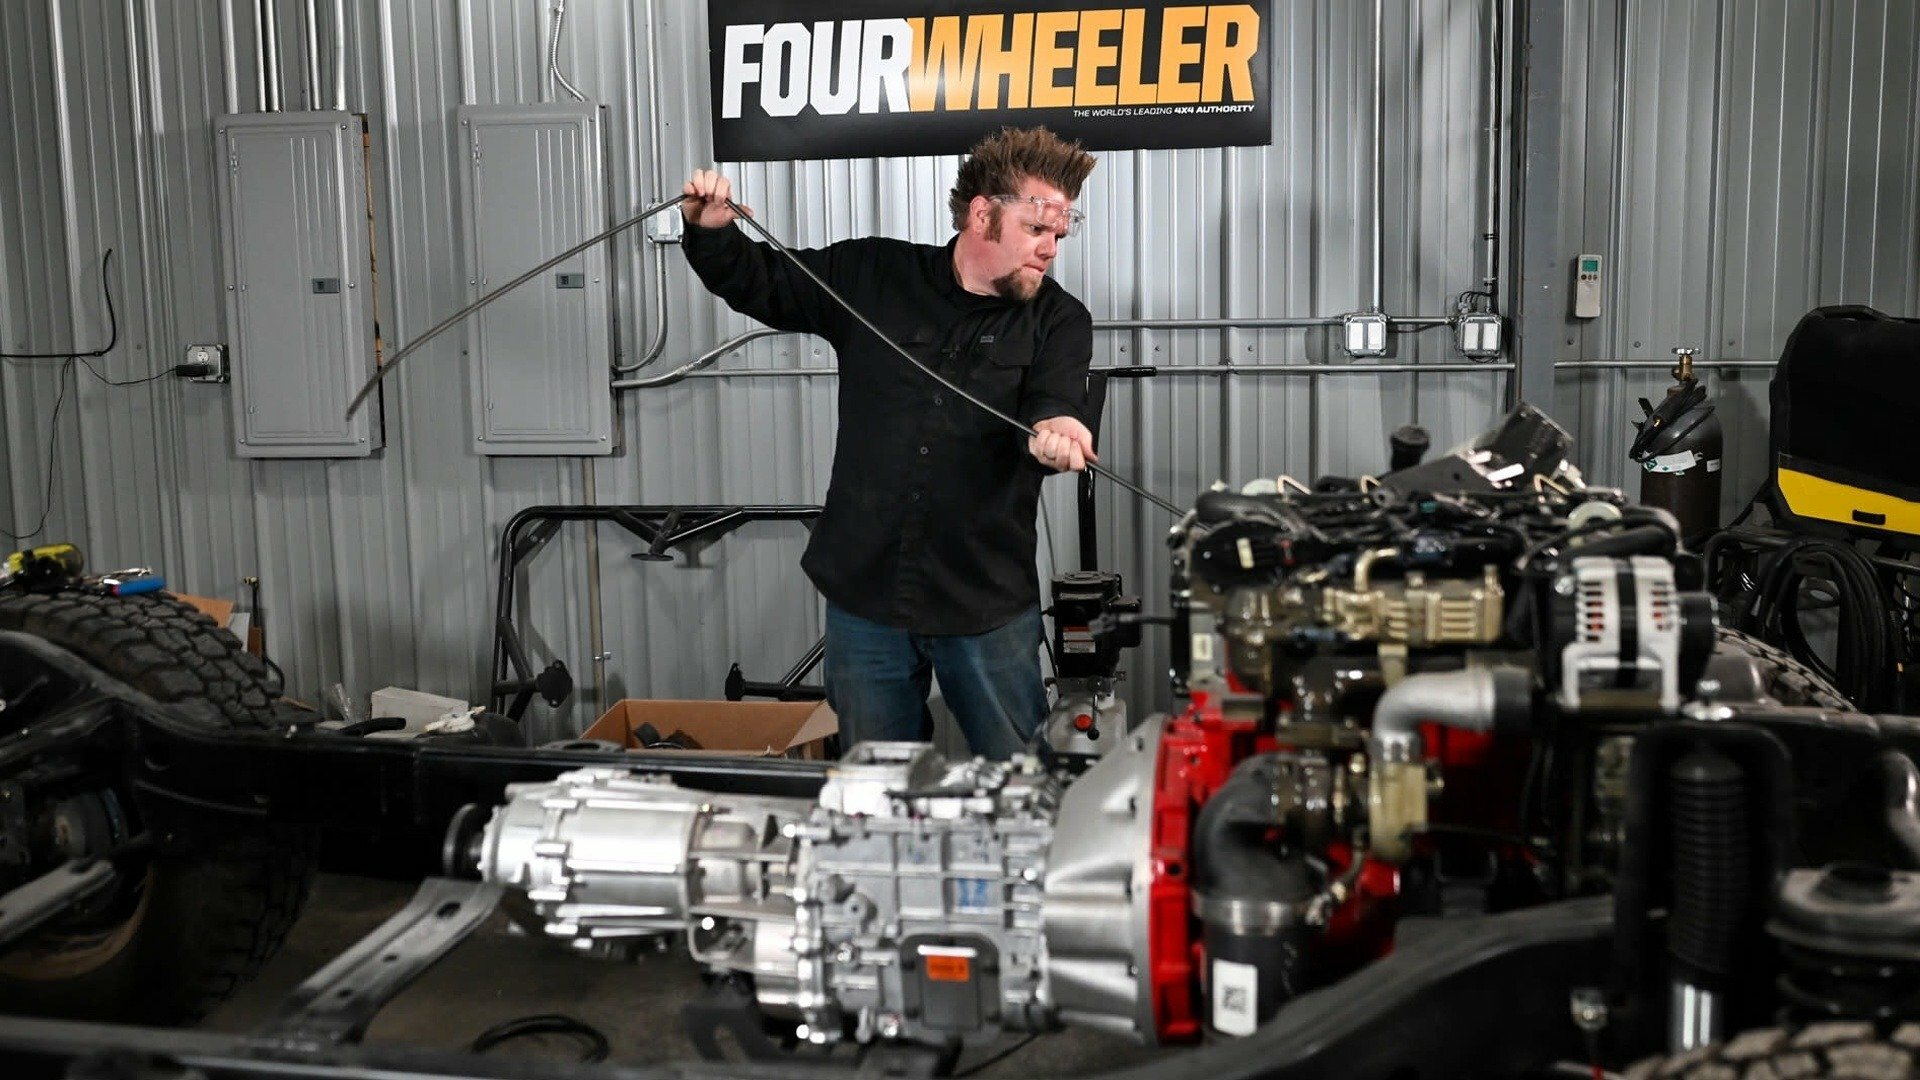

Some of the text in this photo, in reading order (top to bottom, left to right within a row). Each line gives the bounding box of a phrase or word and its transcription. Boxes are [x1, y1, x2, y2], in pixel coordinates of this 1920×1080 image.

[1073, 105, 1255, 117] THE WORLD'S LEADING 4X4 AUTHORITY
